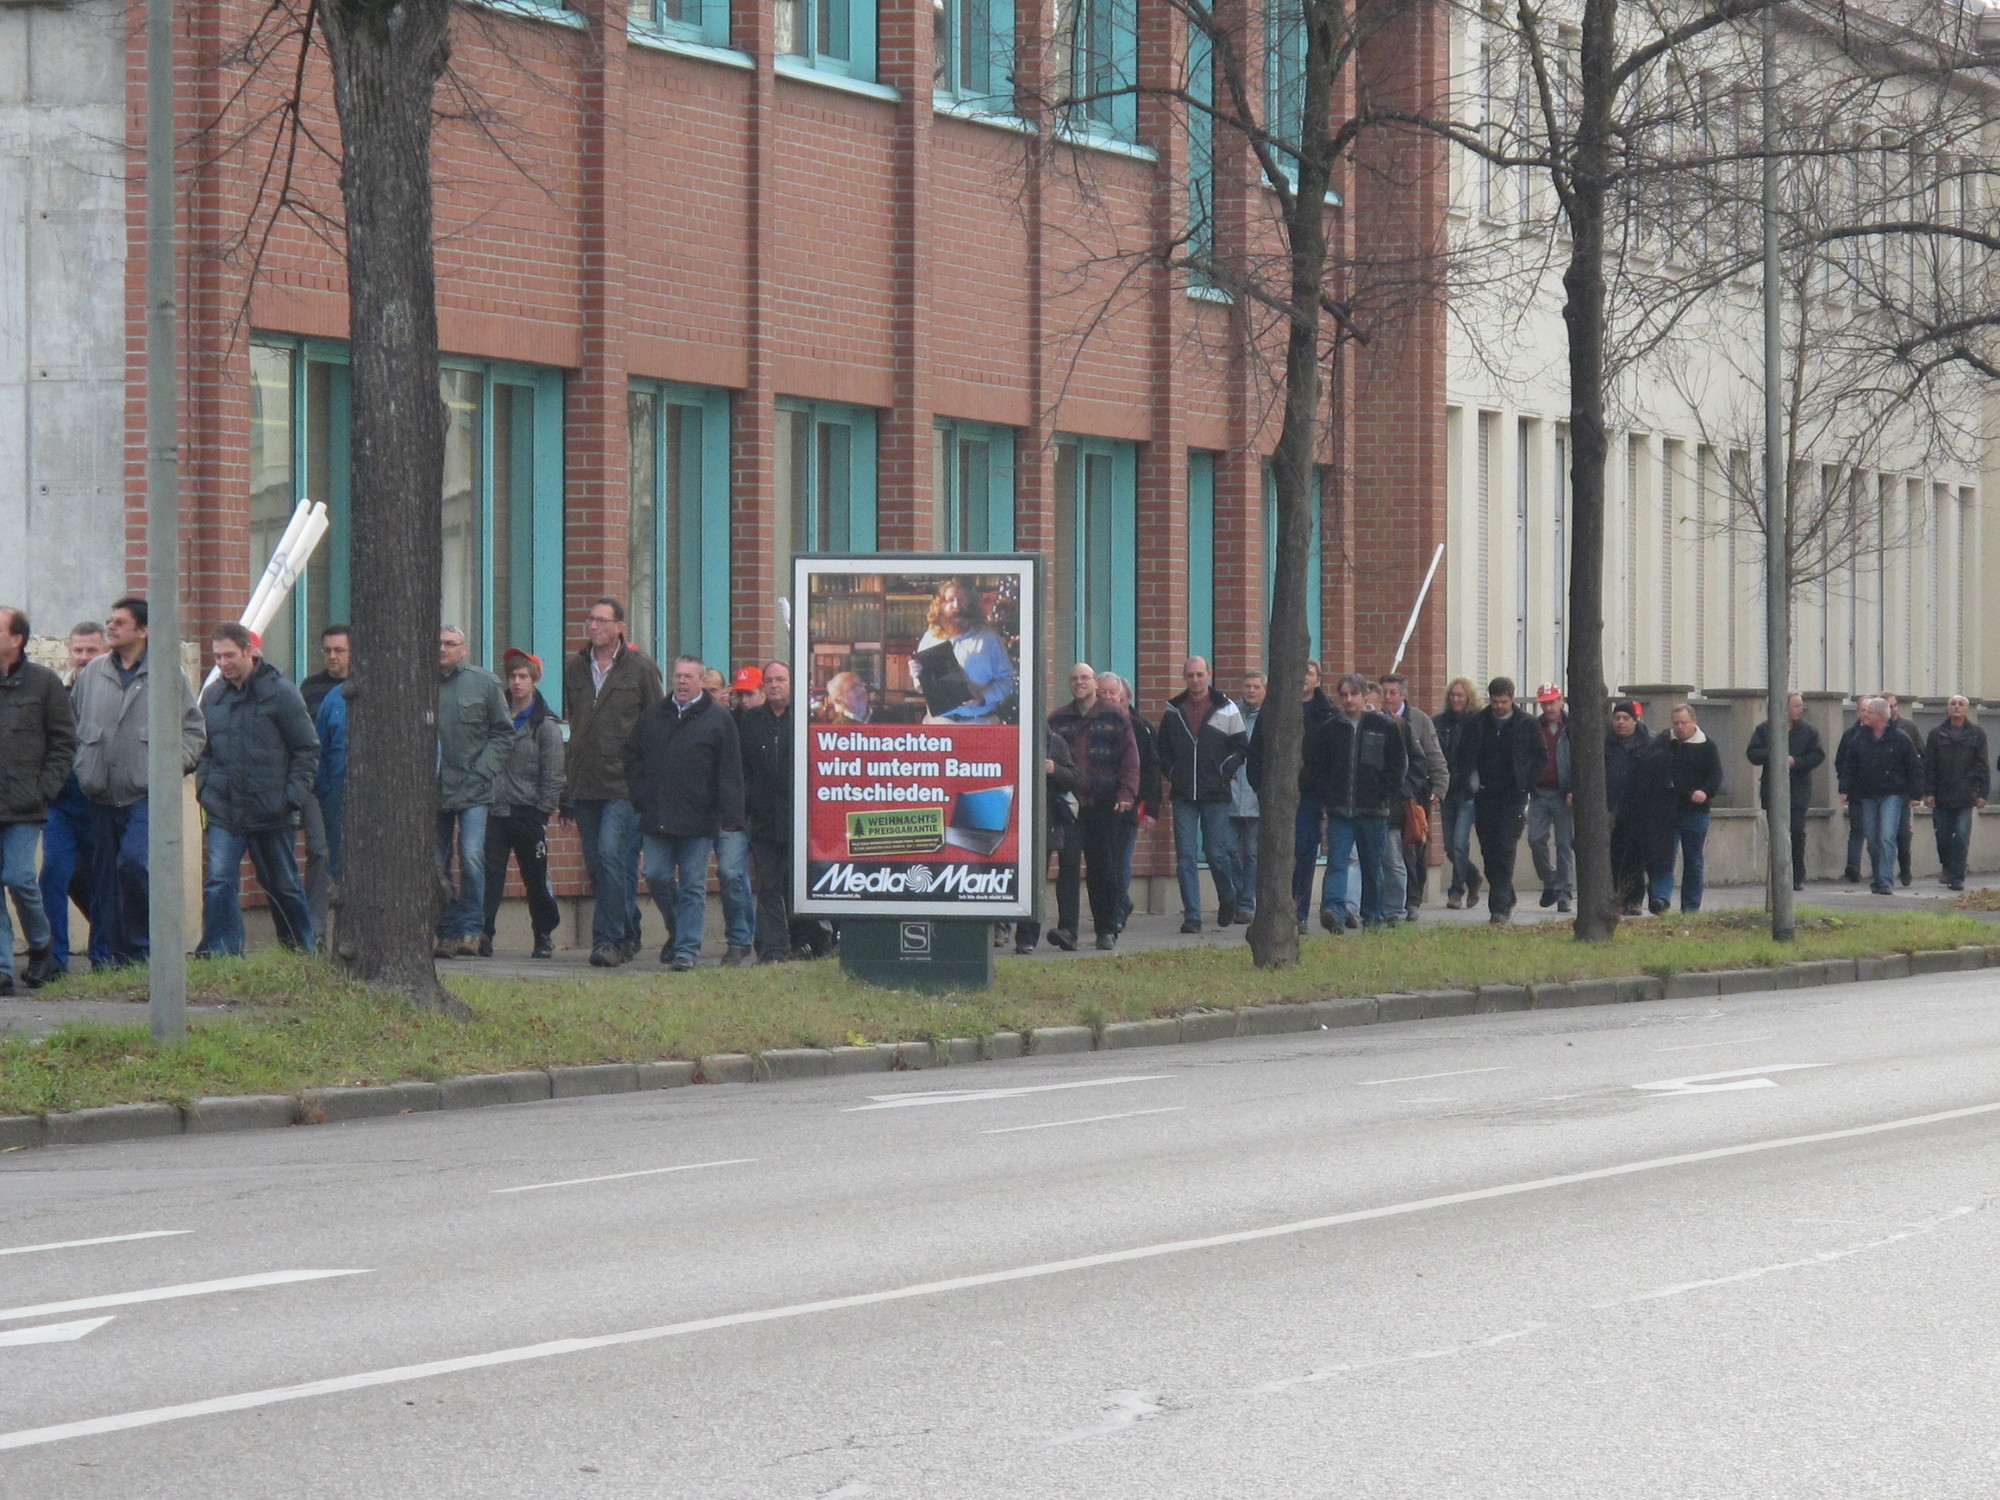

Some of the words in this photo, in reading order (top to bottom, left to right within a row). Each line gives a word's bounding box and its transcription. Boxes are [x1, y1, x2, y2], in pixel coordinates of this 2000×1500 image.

[817, 732, 952, 752] Weihnachten
[817, 757, 861, 776] wird
[867, 758, 940, 777] unterm
[945, 758, 1002, 777] Baum
[817, 782, 950, 802] entschieden.
[868, 824, 938, 836] PREISGARANTIE
[812, 863, 905, 893] Media
[927, 864, 1013, 893] Markt
[904, 925, 927, 949] S
